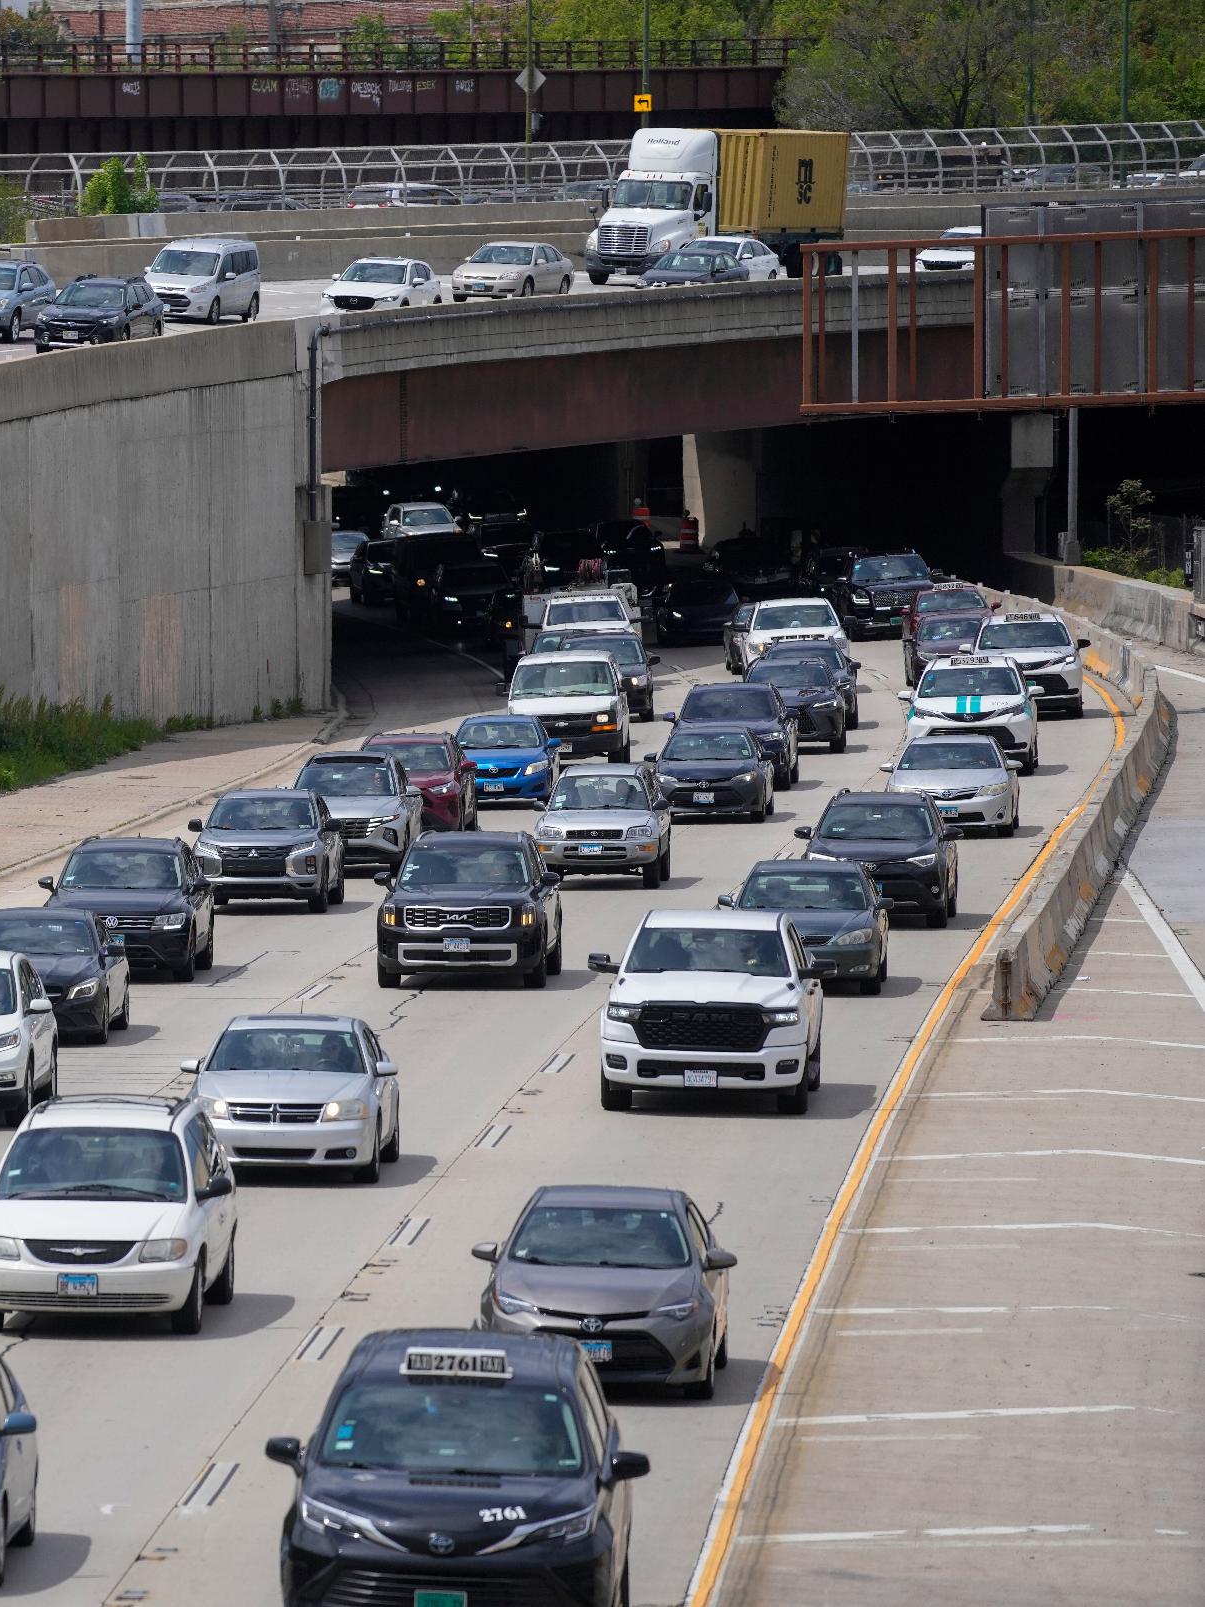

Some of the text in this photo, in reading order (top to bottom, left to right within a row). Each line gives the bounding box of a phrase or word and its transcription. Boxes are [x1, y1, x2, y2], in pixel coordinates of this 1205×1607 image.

[251, 78, 278, 92] EXAM
[647, 137, 681, 146] Holland
[435, 1355, 477, 1371] 2761
[478, 1505, 527, 1522] 2761
